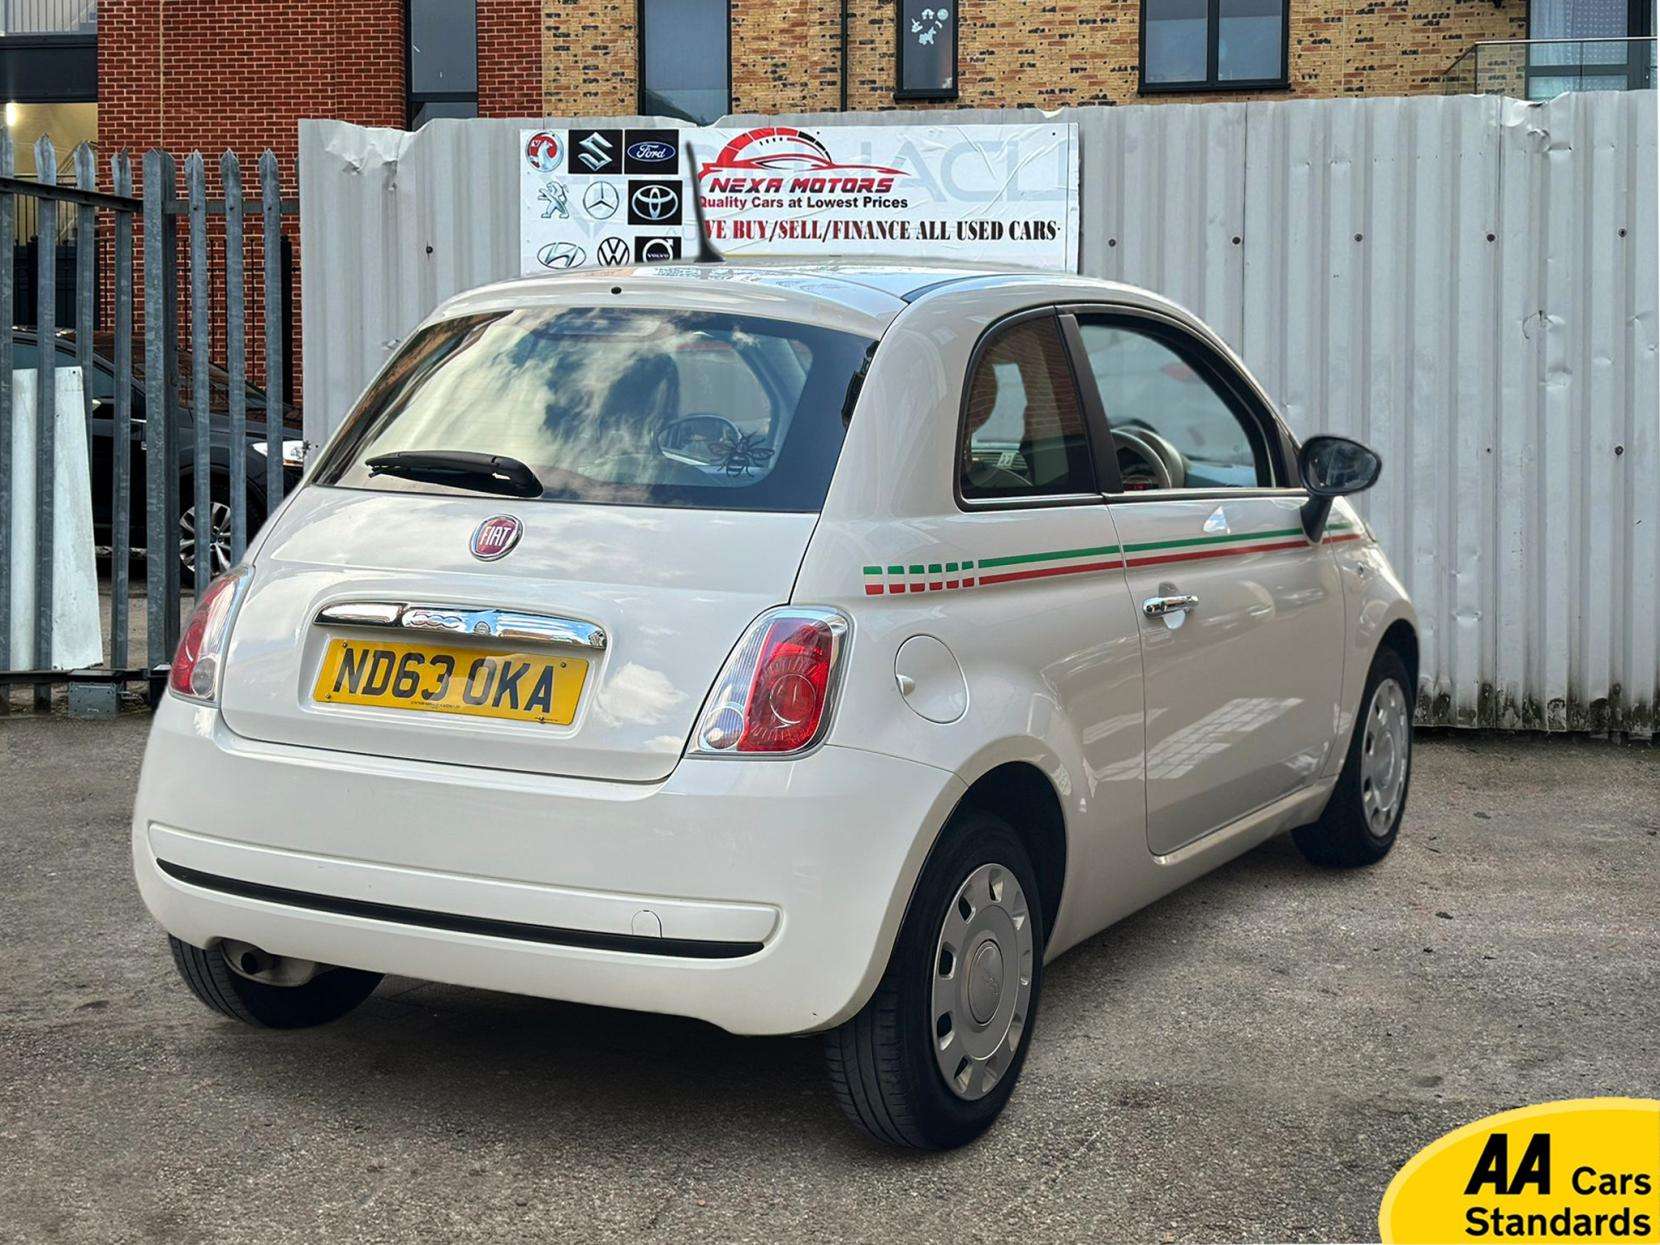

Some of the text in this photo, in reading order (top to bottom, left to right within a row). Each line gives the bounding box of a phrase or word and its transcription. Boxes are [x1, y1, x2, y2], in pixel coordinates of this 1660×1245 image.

[636, 144, 667, 159] Ford
[709, 177, 894, 194] NEXA MOTORS
[699, 195, 908, 210] Quality Cars at Lowest Prices
[916, 220, 950, 240] ALL
[957, 220, 1004, 240] USED
[1009, 220, 1057, 240] CARS
[479, 525, 512, 546] FIAT
[333, 648, 454, 702] ND63
